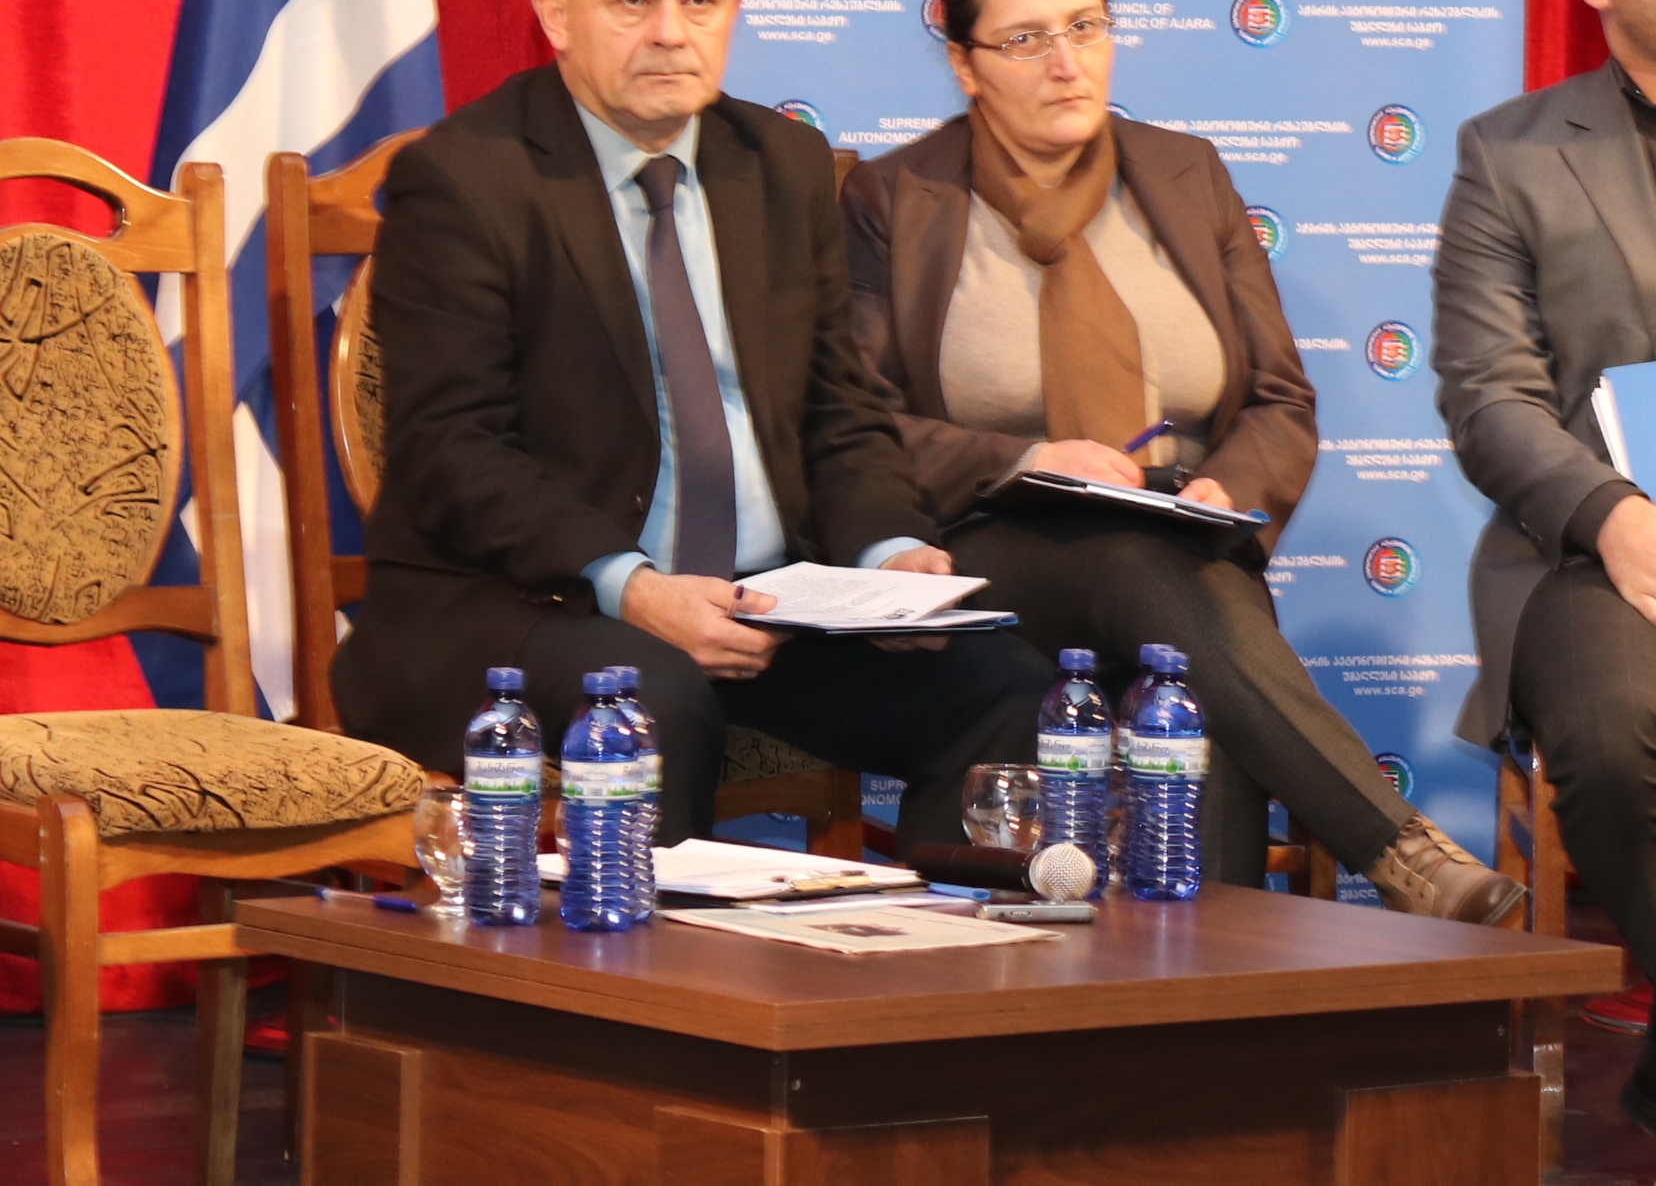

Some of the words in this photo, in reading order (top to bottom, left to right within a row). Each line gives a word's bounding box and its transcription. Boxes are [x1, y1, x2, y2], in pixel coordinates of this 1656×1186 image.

[1107, 2, 1151, 15] OUNCIL
[1152, 2, 1174, 15] OF
[1149, 17, 1167, 29] OF
[1169, 17, 1215, 30] AJARA
[758, 29, 834, 42] www.sca.ge
[1359, 35, 1435, 48] www.sca.ge
[1356, 252, 1432, 265] www.sca.ge
[1355, 468, 1431, 481] www.sca.ge
[1354, 684, 1427, 696] www.sca.ge
[869, 779, 905, 792] SUPR
